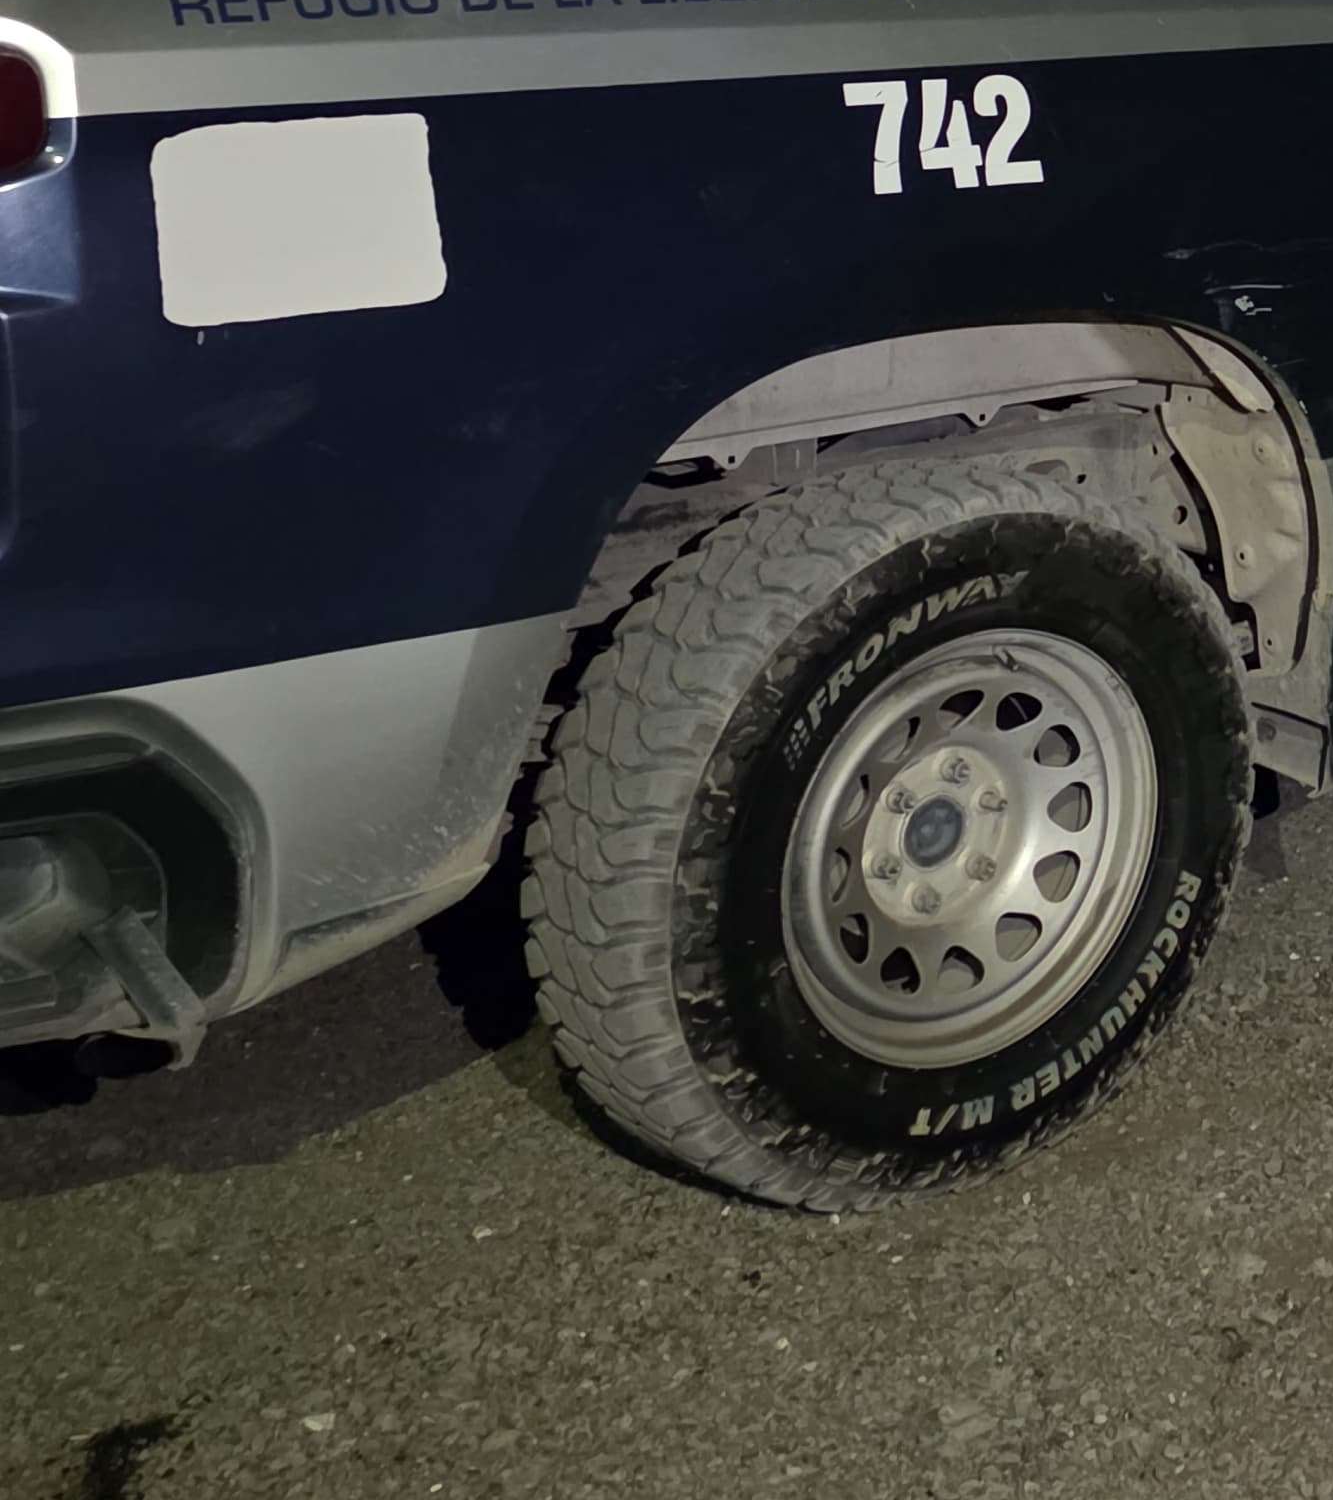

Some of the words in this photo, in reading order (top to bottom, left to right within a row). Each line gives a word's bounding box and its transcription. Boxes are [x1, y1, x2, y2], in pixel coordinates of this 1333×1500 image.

[842, 75, 1044, 195] 742
[806, 570, 1029, 730] FRONWAY
[1009, 870, 1202, 1112] ROCKHUNTER
[908, 1096, 995, 1137] M/T
